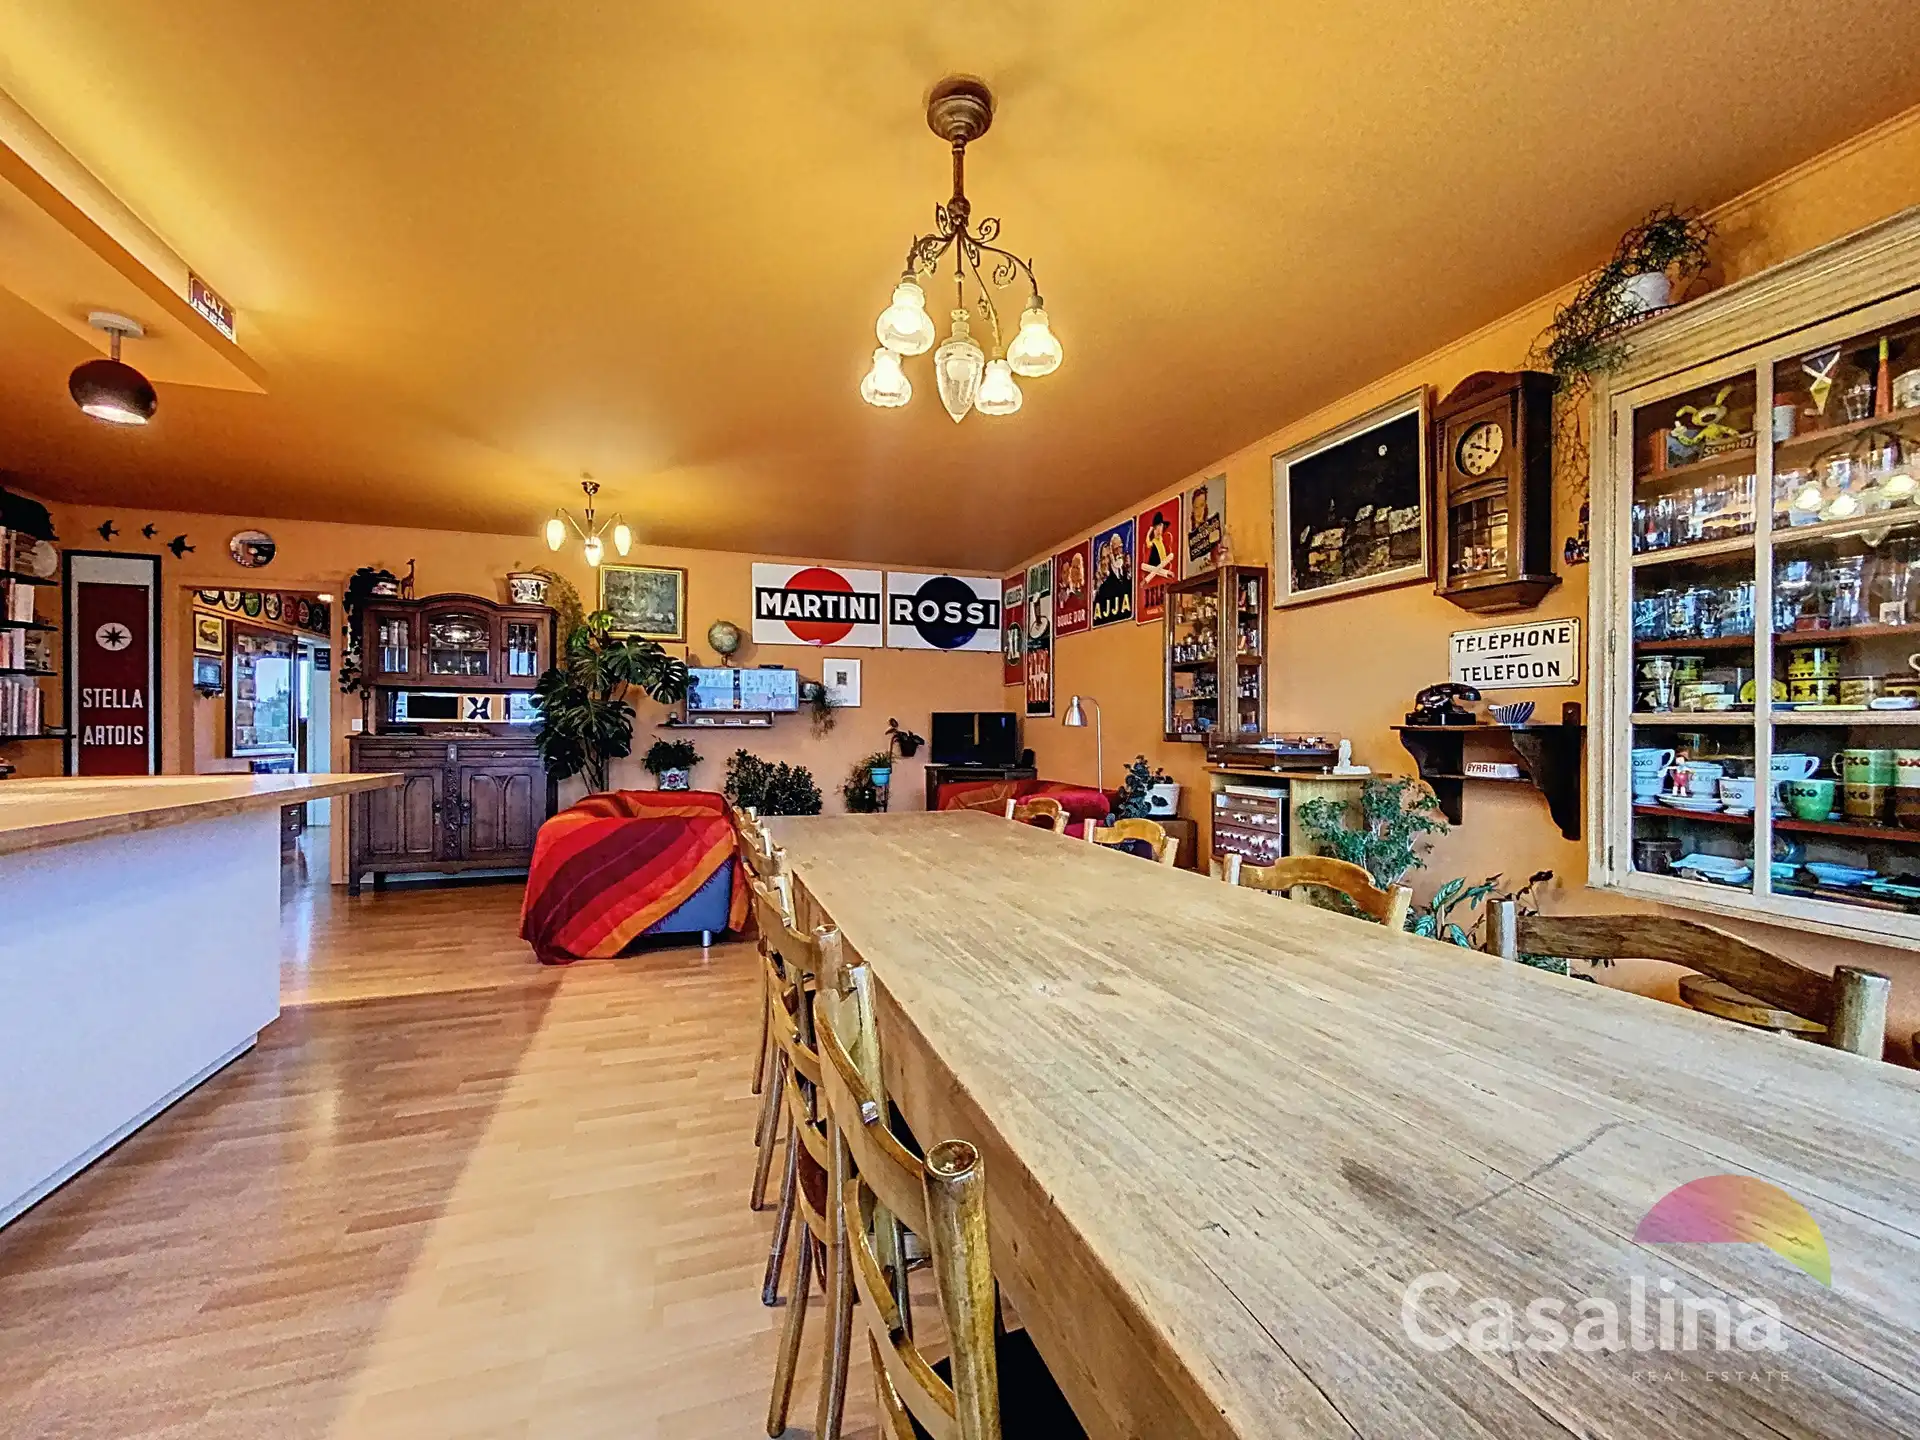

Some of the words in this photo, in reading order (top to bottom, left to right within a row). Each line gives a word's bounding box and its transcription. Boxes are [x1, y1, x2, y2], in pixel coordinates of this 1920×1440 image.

[760, 592, 876, 620] MARTINI
[894, 600, 996, 625] ROSSI
[1093, 594, 1131, 620] AJJA
[1461, 661, 1561, 682] TELEFOON
[82, 688, 144, 709] STELLA
[83, 725, 144, 746] ARTOIS
